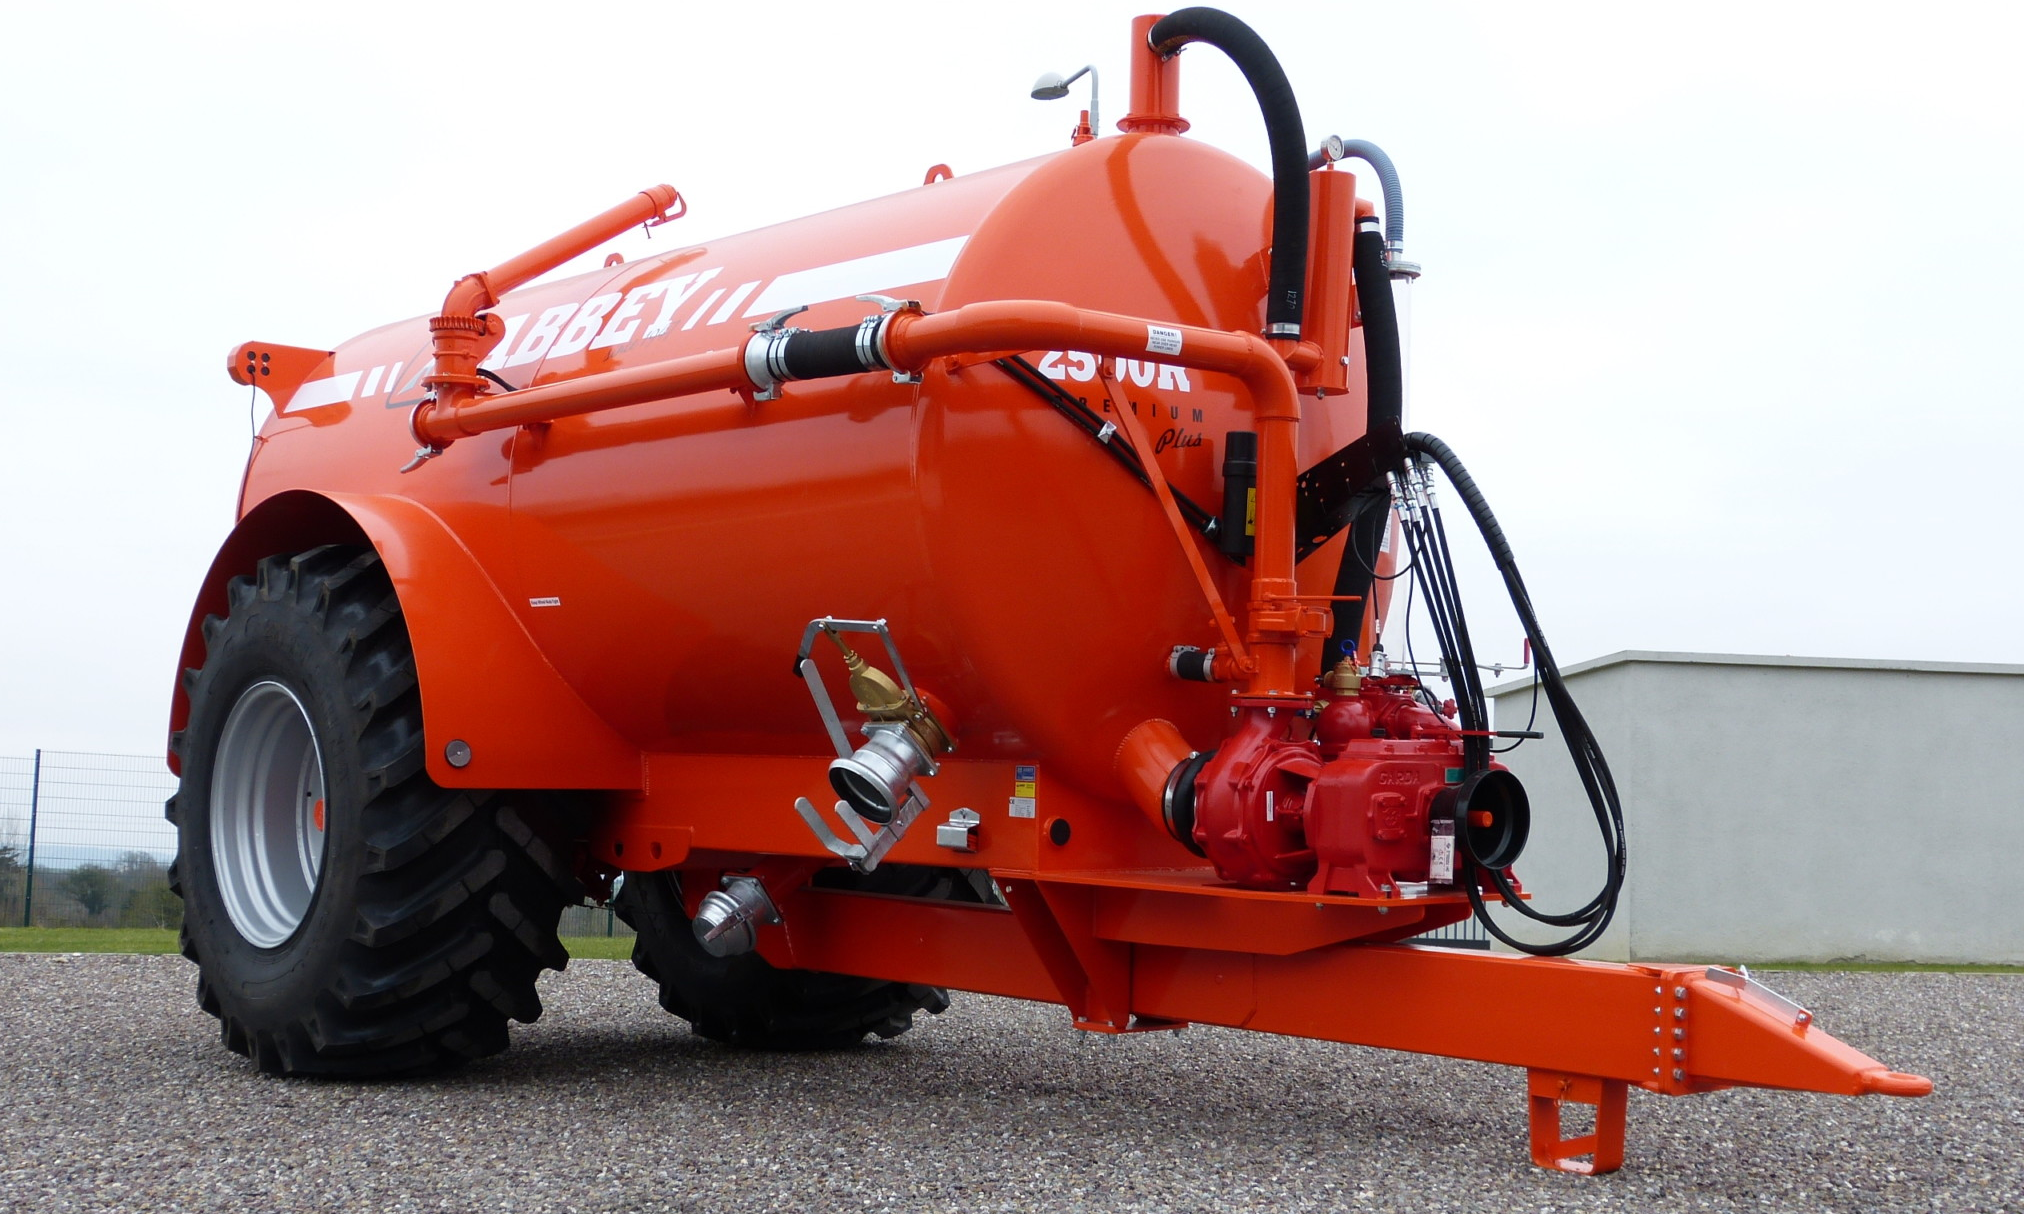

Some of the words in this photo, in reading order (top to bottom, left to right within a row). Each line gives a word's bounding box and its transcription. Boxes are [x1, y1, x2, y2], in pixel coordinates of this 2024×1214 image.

[1152, 329, 1177, 337] DANGER!
[1155, 427, 1203, 454] Plus
[1379, 771, 1421, 785] GARDA
